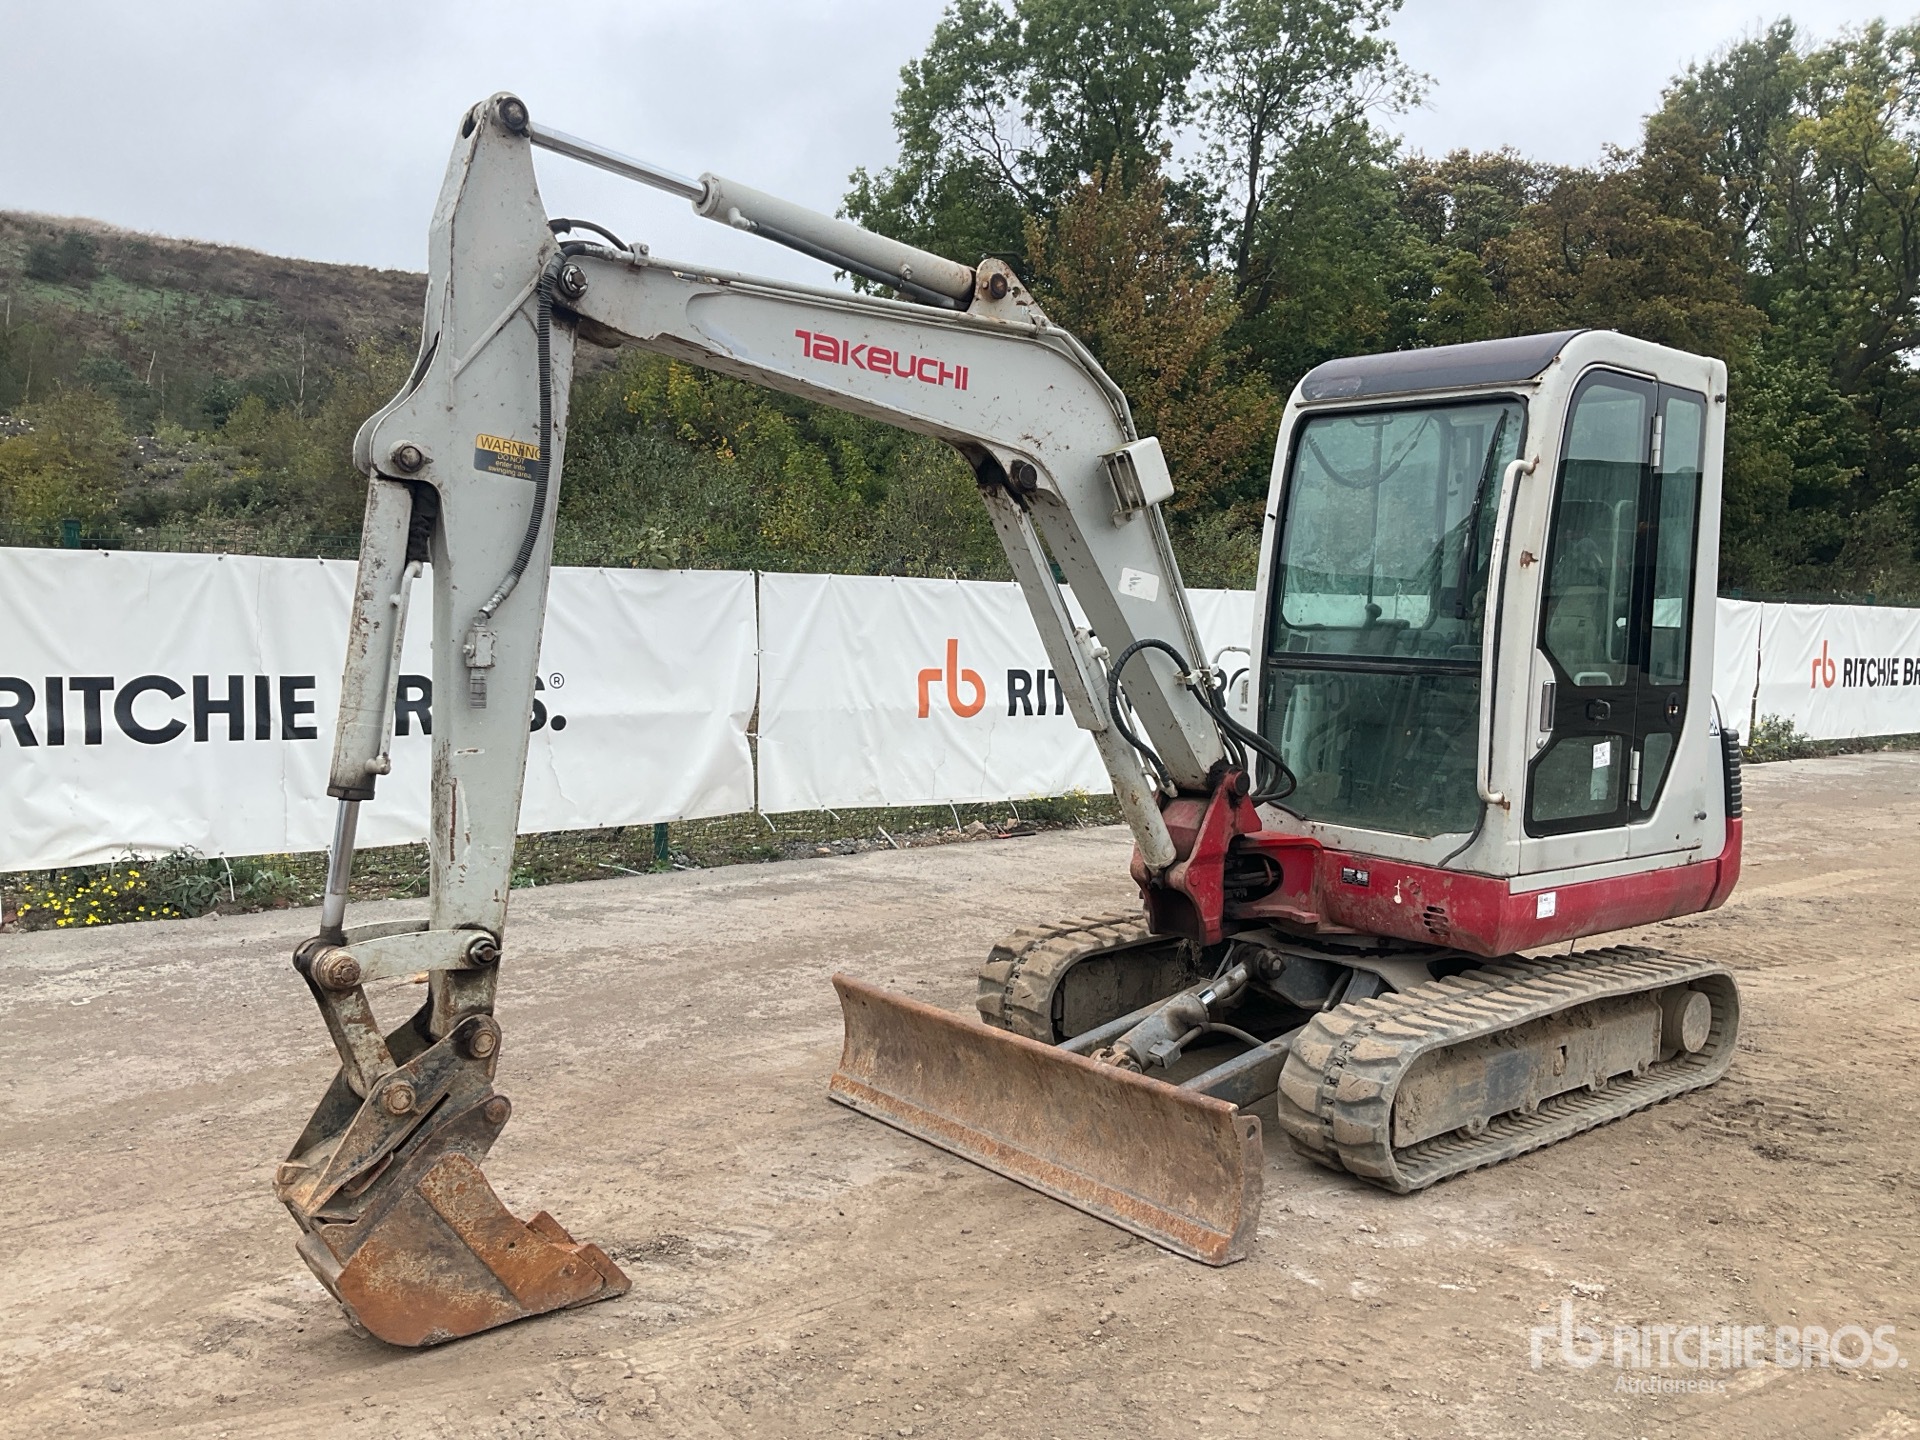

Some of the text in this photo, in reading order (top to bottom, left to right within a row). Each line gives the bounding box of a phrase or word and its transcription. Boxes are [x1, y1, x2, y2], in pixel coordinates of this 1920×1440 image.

[497, 453, 525, 465] DO NOT
[517, 471, 532, 479] area
[1843, 658, 1899, 687] RITCHIE
[0, 675, 317, 748] RITCHIE
